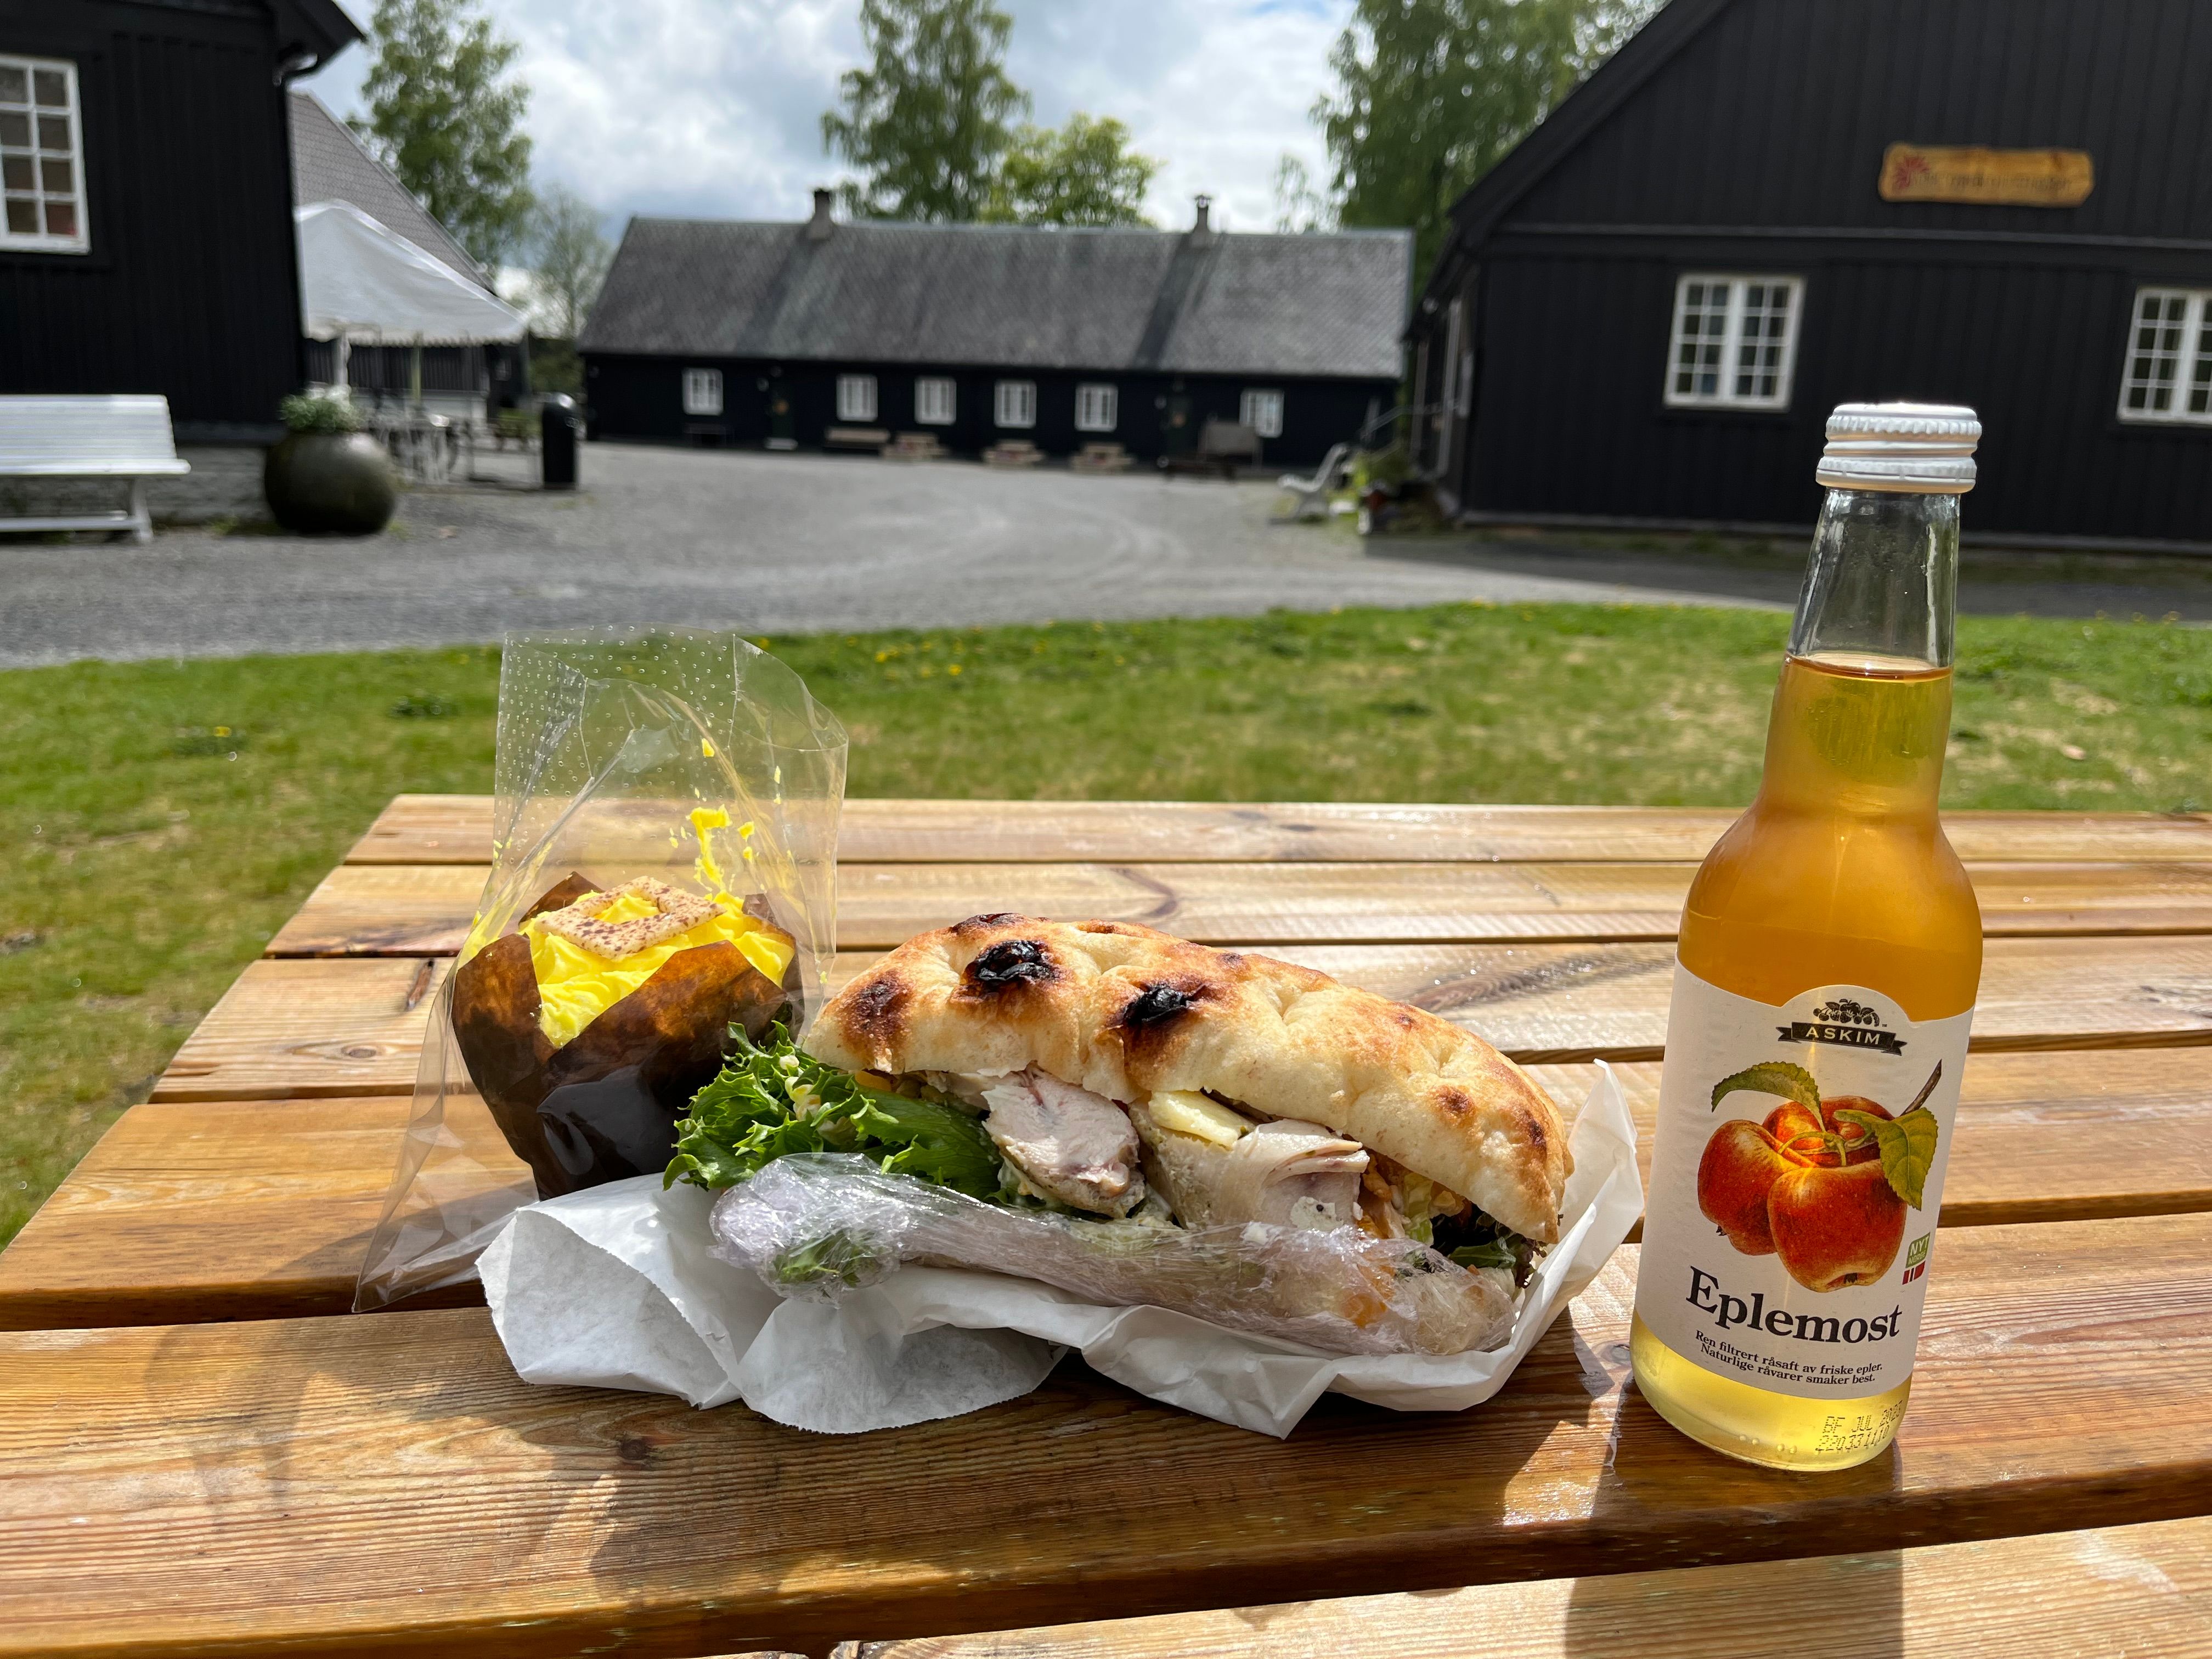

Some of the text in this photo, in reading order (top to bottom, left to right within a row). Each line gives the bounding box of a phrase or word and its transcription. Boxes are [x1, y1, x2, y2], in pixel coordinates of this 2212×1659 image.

[1805, 1026, 1880, 1045] ASKIM
[1910, 1235, 1929, 1256] NYT
[1685, 1266, 1903, 1344] Eplemost
[1695, 1329, 1883, 1375] Ren filtrert råsaft av friske epler.
[1700, 1342, 1876, 1385] Naturlige råvarer smaker best.
[1851, 1415, 1873, 1432] JUL
